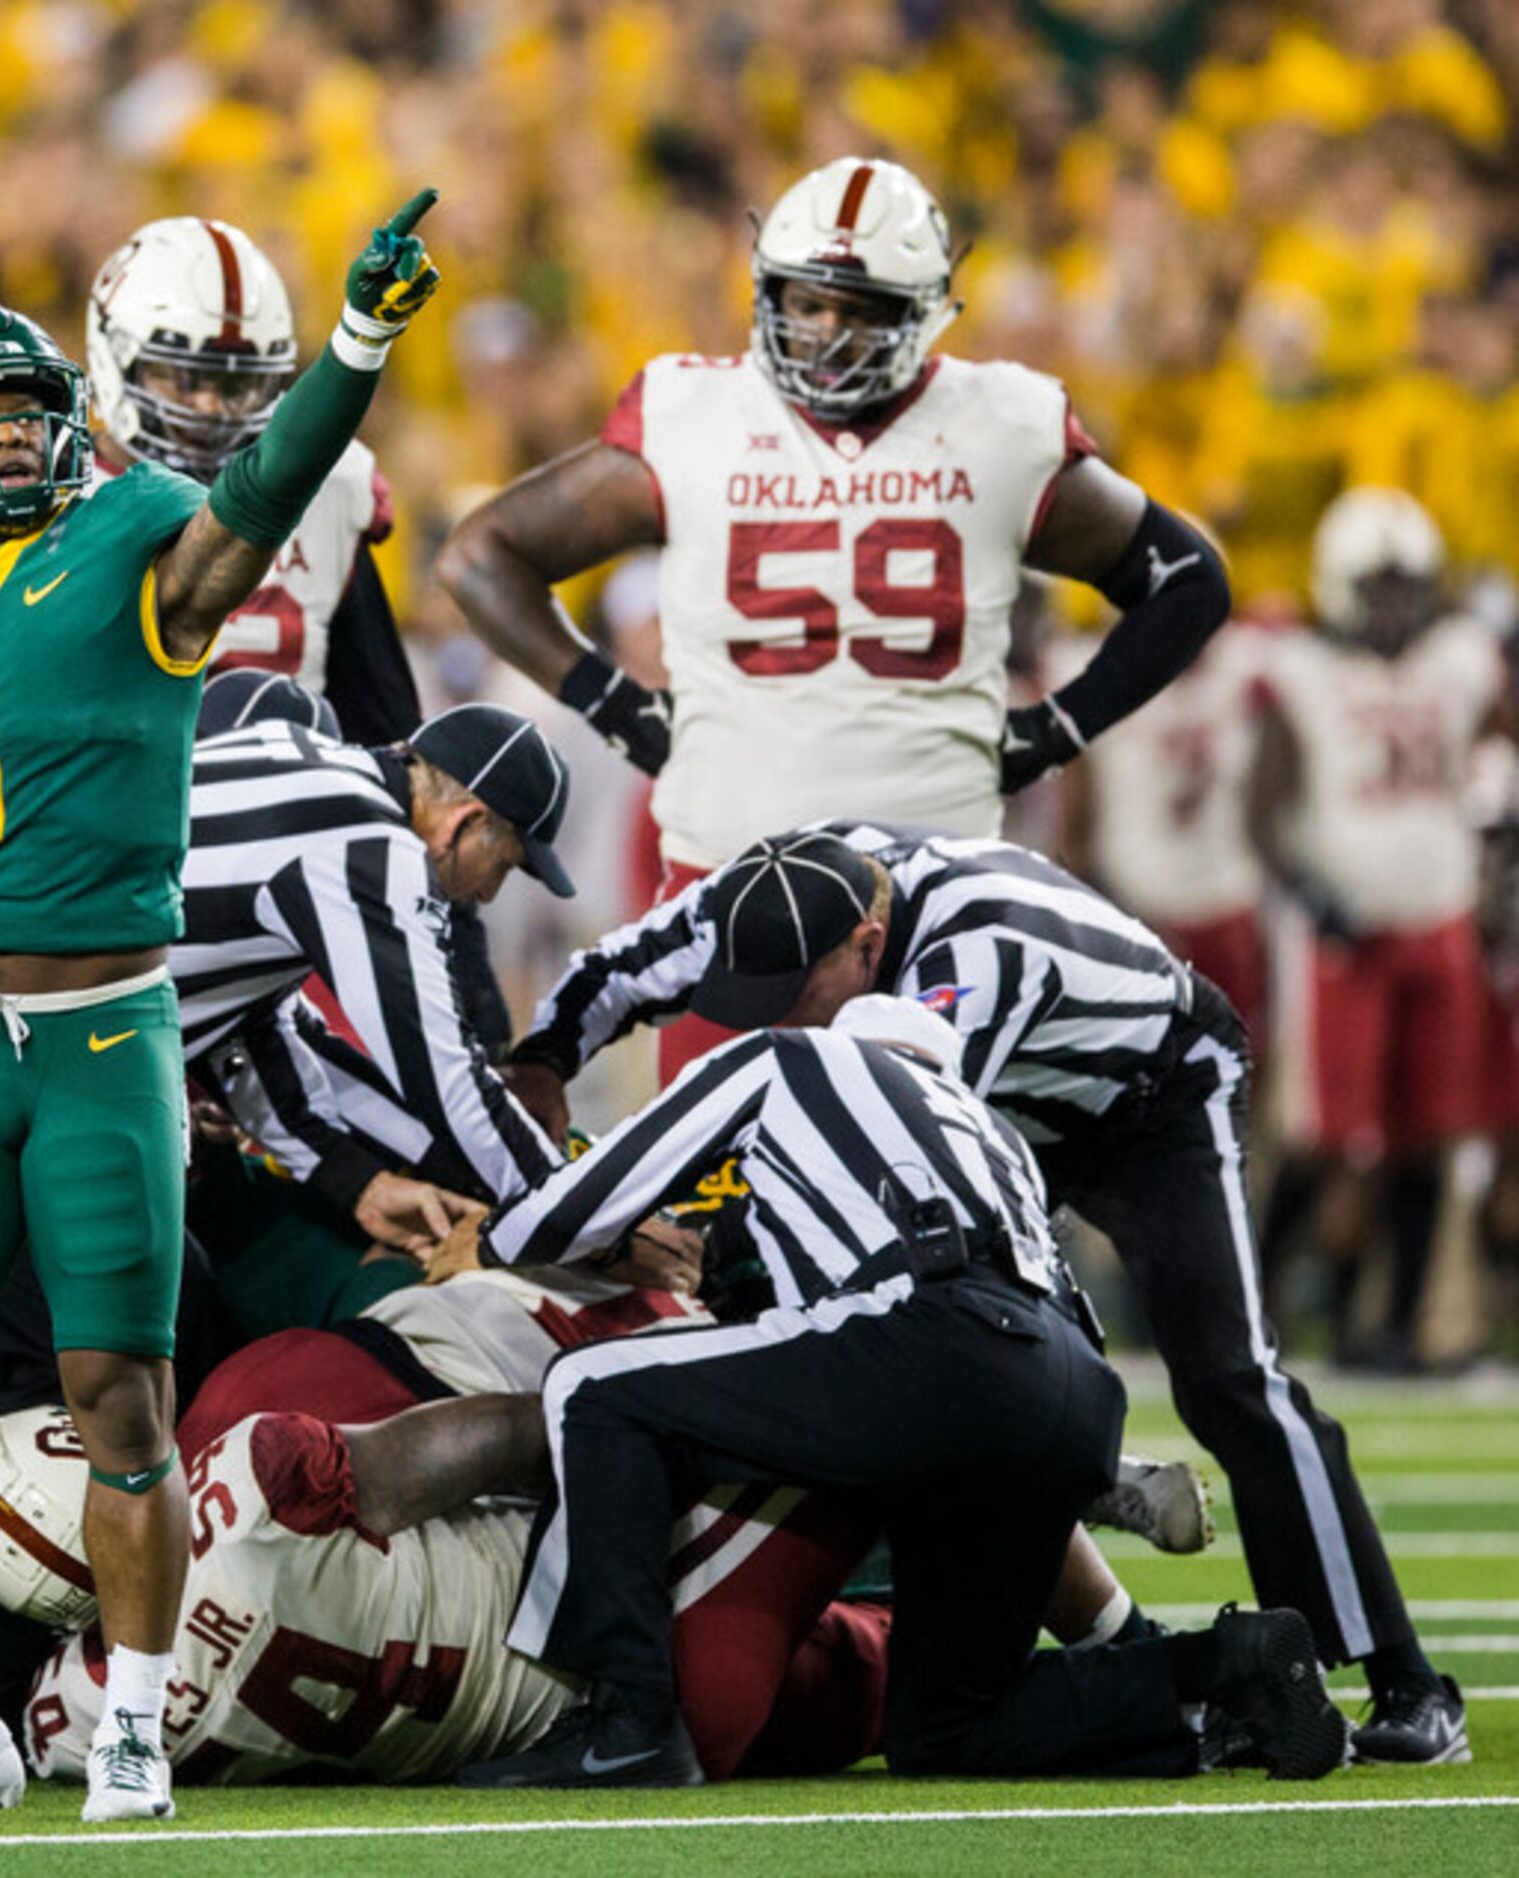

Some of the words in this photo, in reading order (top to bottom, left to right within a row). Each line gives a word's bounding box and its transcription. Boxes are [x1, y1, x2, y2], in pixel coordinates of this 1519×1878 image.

[726, 469, 975, 511] OKLAHOMA
[725, 517, 967, 682] 59
[185, 1597, 257, 1671] JR.
[206, 1624, 469, 1768] 4
